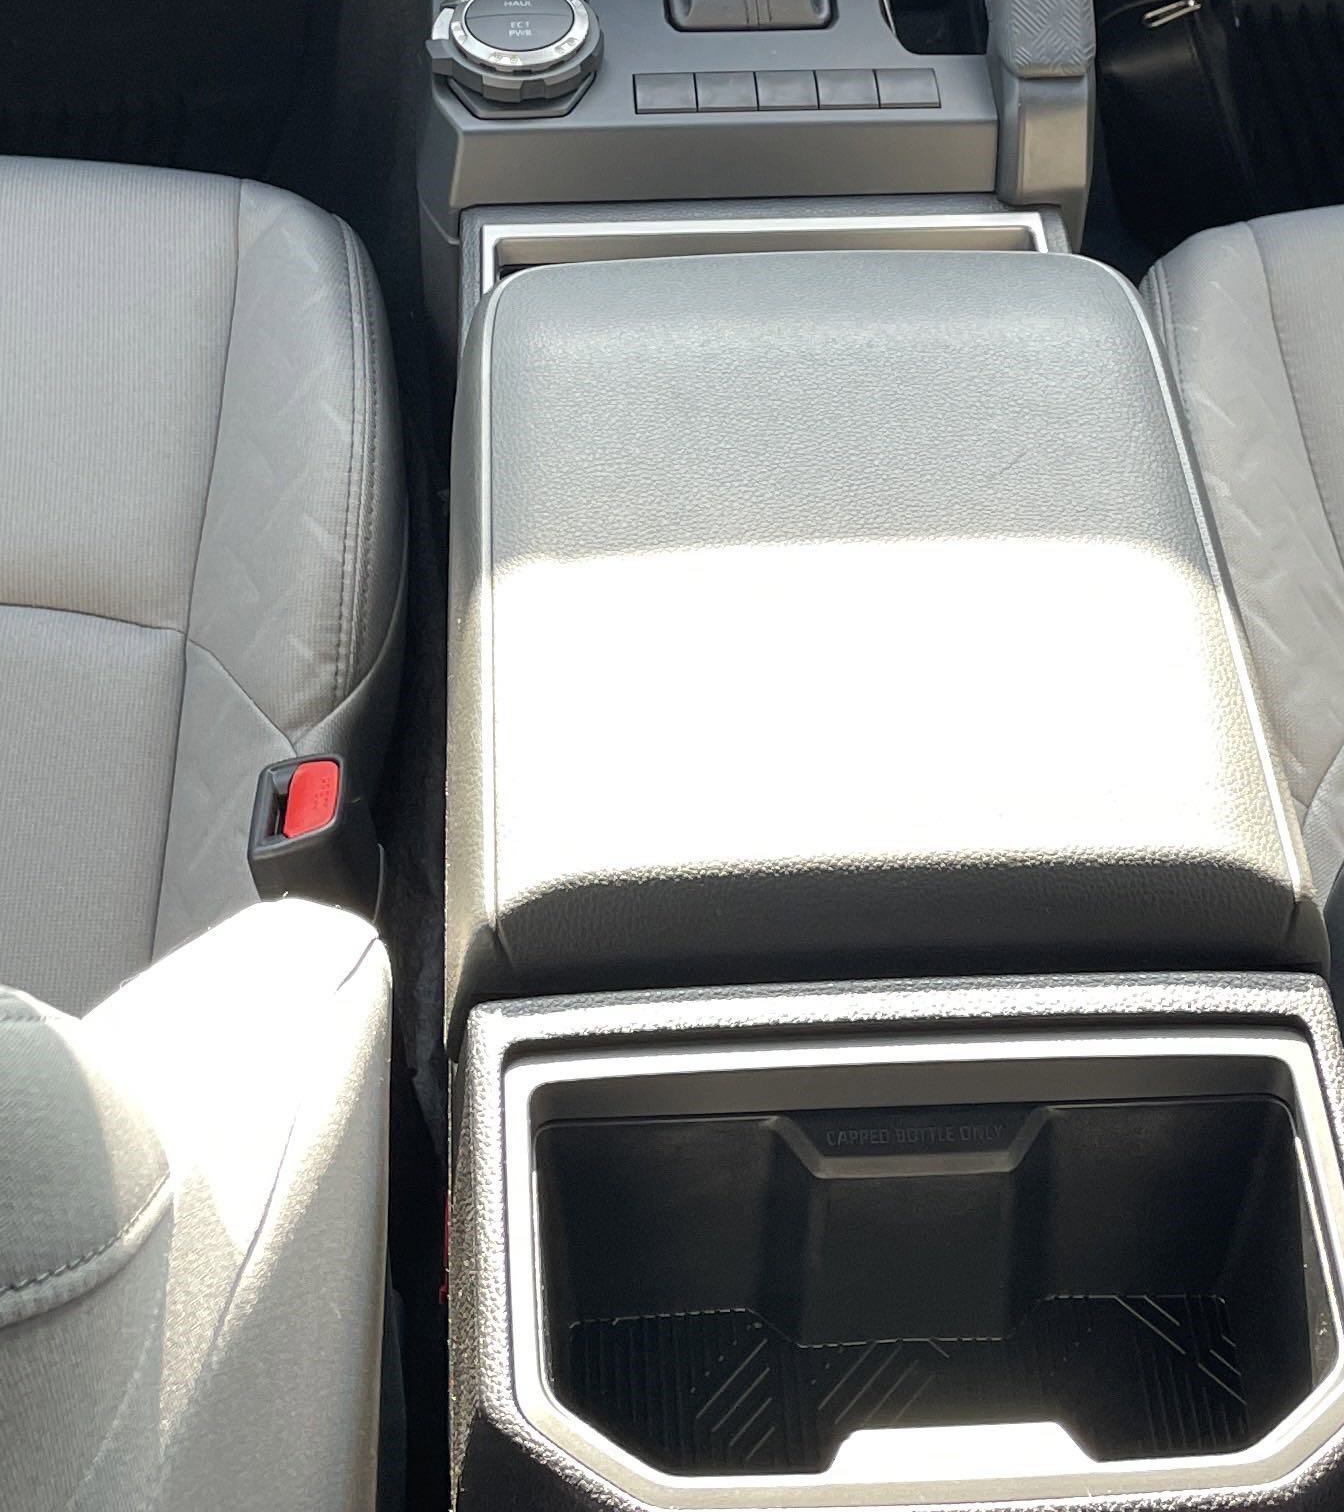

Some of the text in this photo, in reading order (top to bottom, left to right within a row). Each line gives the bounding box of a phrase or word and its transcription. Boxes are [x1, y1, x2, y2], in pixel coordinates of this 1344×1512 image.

[826, 1123, 1004, 1147] CAPPED BOTTLE ONLY
